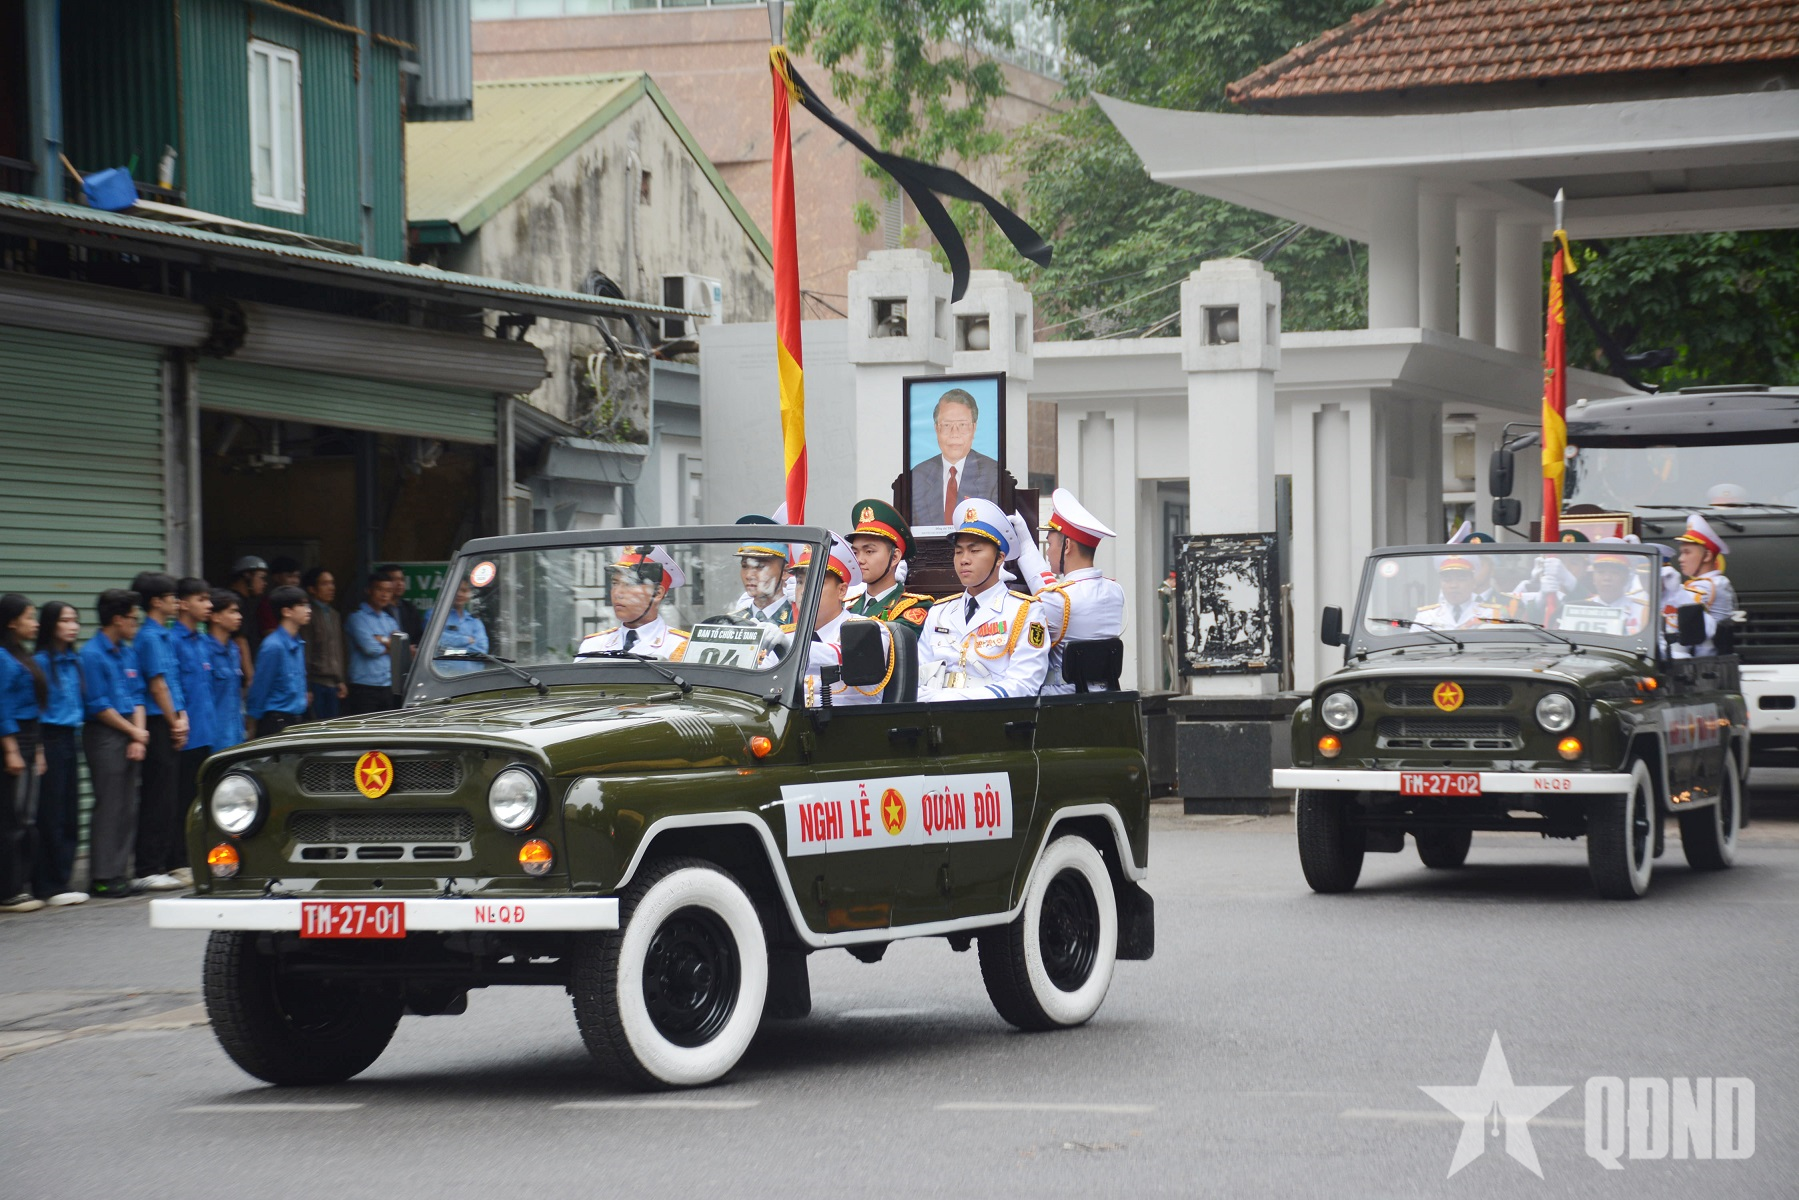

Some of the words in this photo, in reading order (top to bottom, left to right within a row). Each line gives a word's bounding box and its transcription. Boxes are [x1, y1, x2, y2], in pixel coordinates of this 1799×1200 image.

[697, 629, 711, 638] BAN
[743, 631, 758, 640] TANG
[1402, 774, 1479, 794] TM-27-02
[799, 800, 843, 843] NGHI
[851, 783, 872, 838] LỄ
[922, 785, 966, 836] QUÂN
[974, 783, 1001, 836] ĐỘI
[303, 904, 399, 935] TM-27-01
